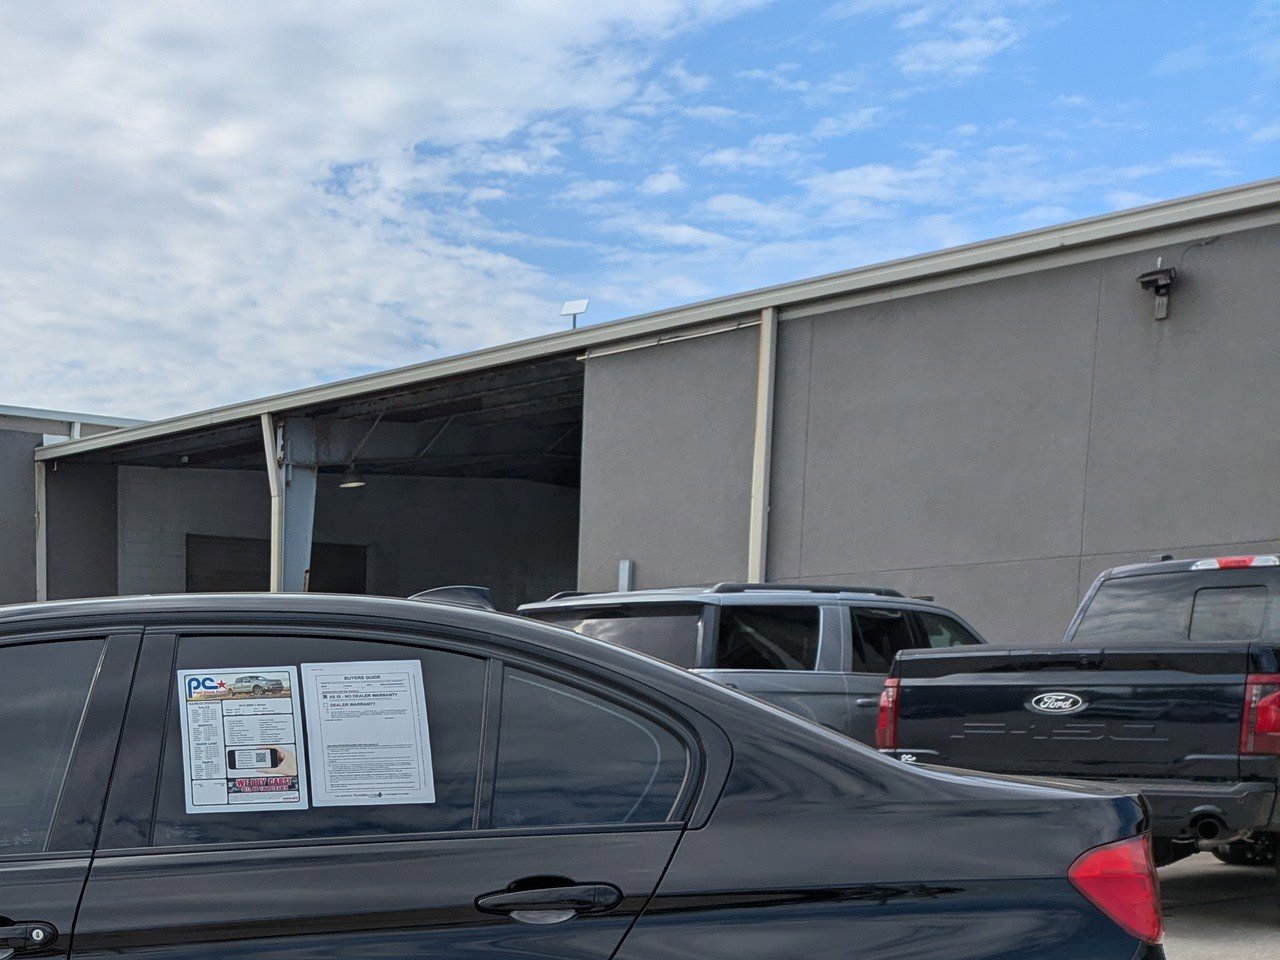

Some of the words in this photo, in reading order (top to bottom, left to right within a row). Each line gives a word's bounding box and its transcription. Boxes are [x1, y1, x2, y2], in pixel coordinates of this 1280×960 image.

[1039, 695, 1072, 709] Ford
[236, 778, 250, 787] WE
[250, 778, 267, 787] BUY
